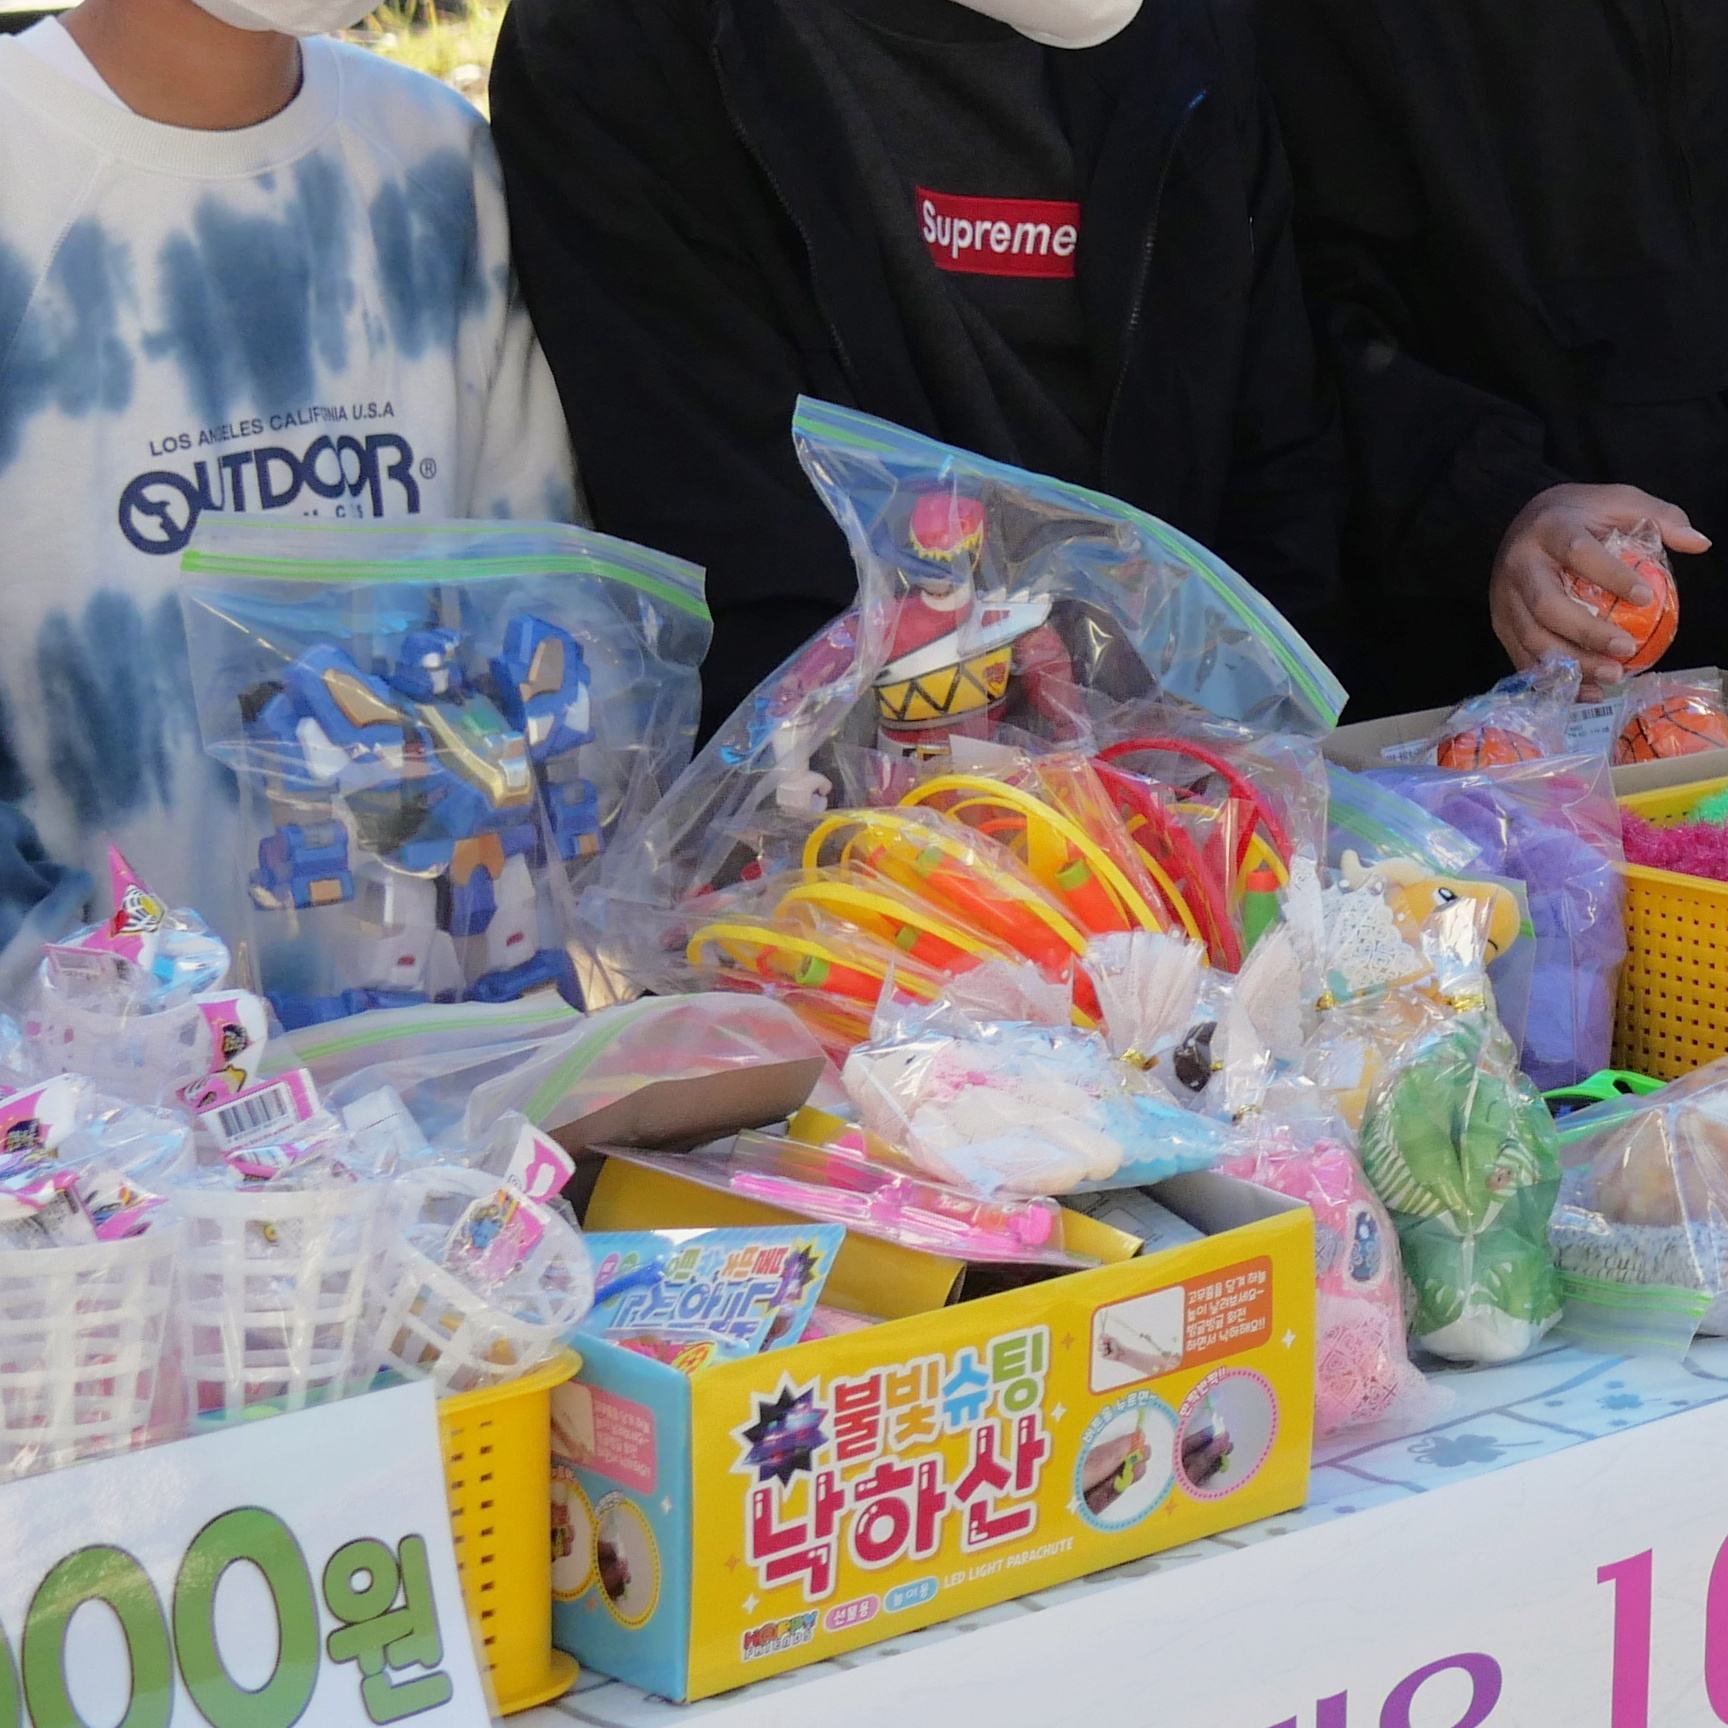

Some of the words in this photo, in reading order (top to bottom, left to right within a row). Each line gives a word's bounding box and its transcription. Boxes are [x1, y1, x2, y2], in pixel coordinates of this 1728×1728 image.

[922, 199, 1078, 259] Supreme
[150, 432, 192, 457] LOS
[118, 433, 421, 556] OUTDOOR
[834, 1331, 1046, 1461] 불빛슈팅
[752, 1414, 1047, 1595] 낙하산
[944, 1571, 966, 1588] LED
[968, 1560, 1004, 1582] LIGHT
[1006, 1536, 1074, 1569] PARACHUTE
[0, 1504, 454, 1727] 00원
[832, 1599, 871, 1624] 선물용
